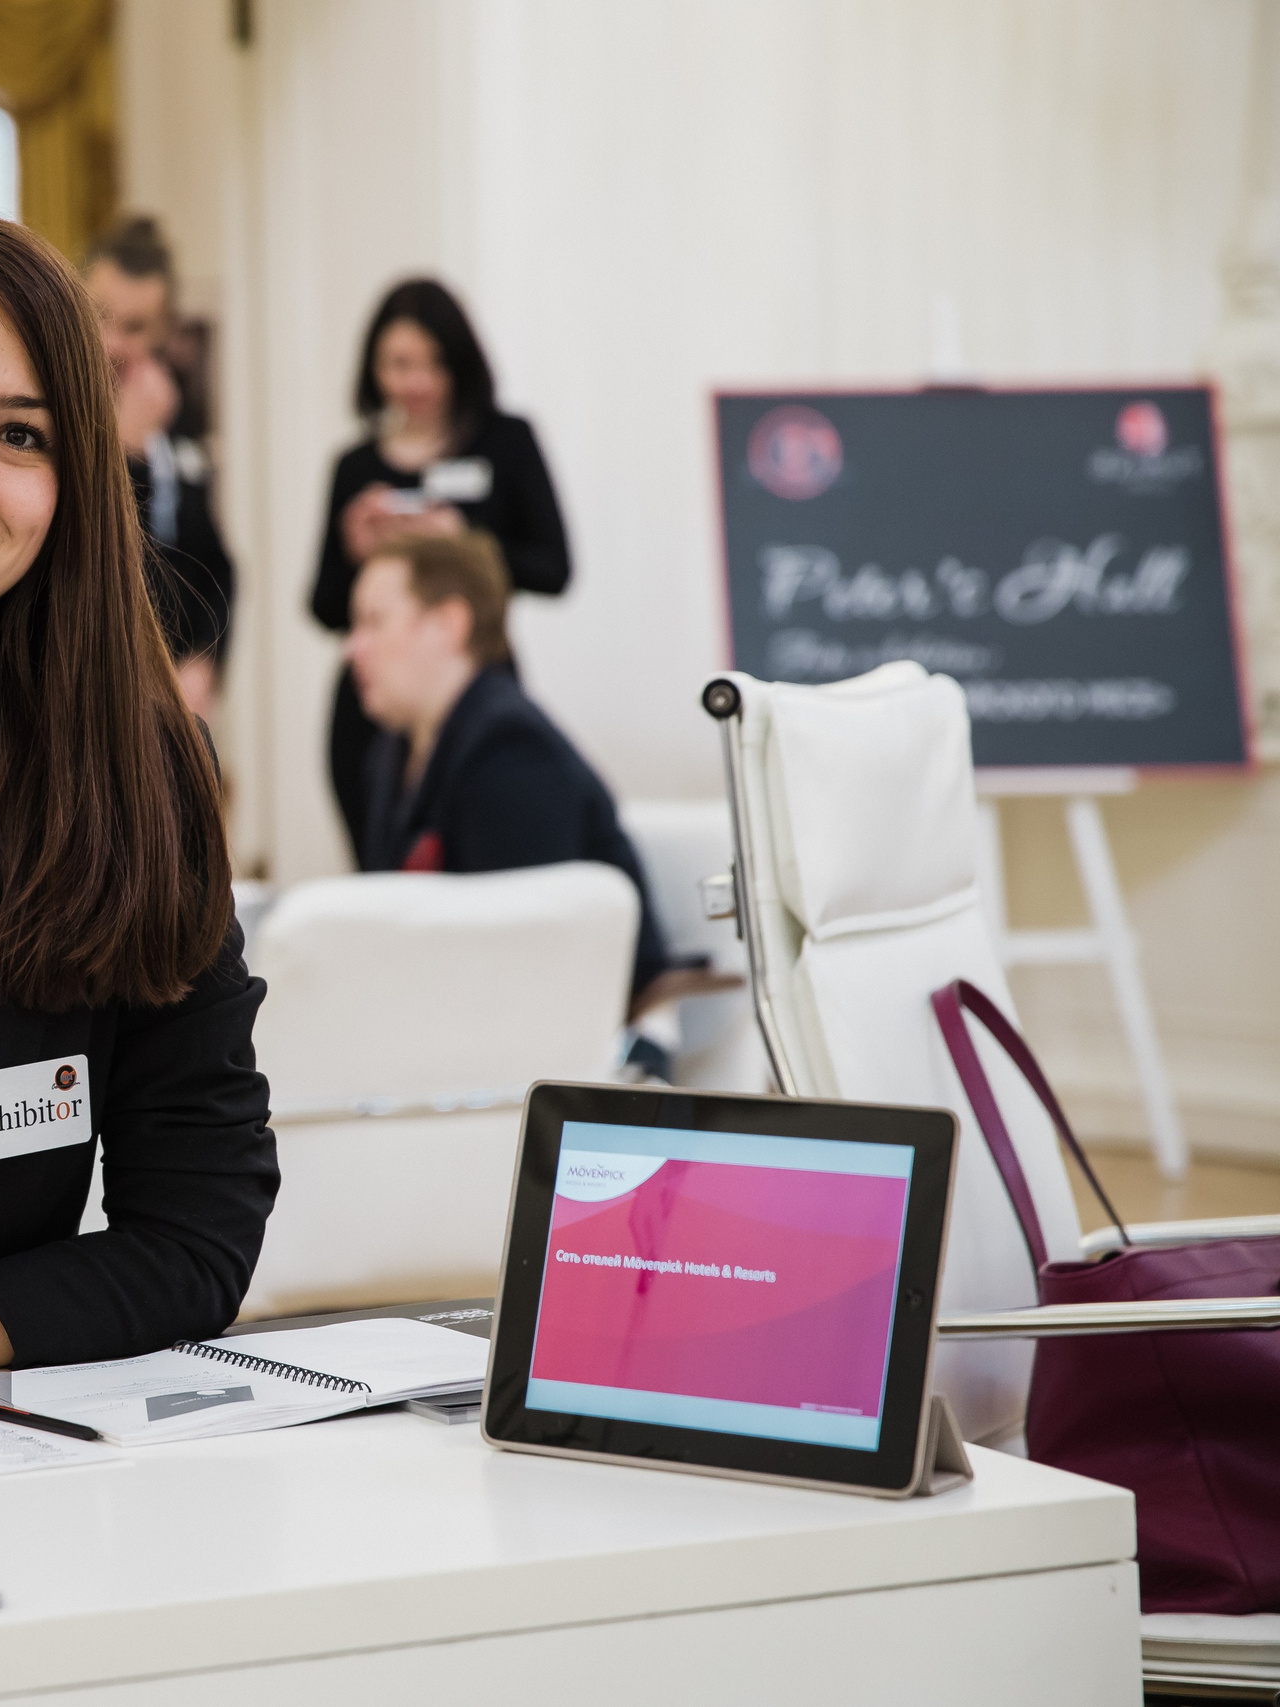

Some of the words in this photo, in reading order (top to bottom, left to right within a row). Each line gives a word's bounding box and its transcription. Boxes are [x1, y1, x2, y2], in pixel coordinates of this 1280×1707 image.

[556, 1249, 581, 1264] Сеть
[582, 1254, 621, 1267] отелей
[623, 1255, 682, 1274] Mövenpick
[684, 1261, 720, 1277] Hotels
[721, 1264, 731, 1278] &
[733, 1265, 776, 1283] Resorts
